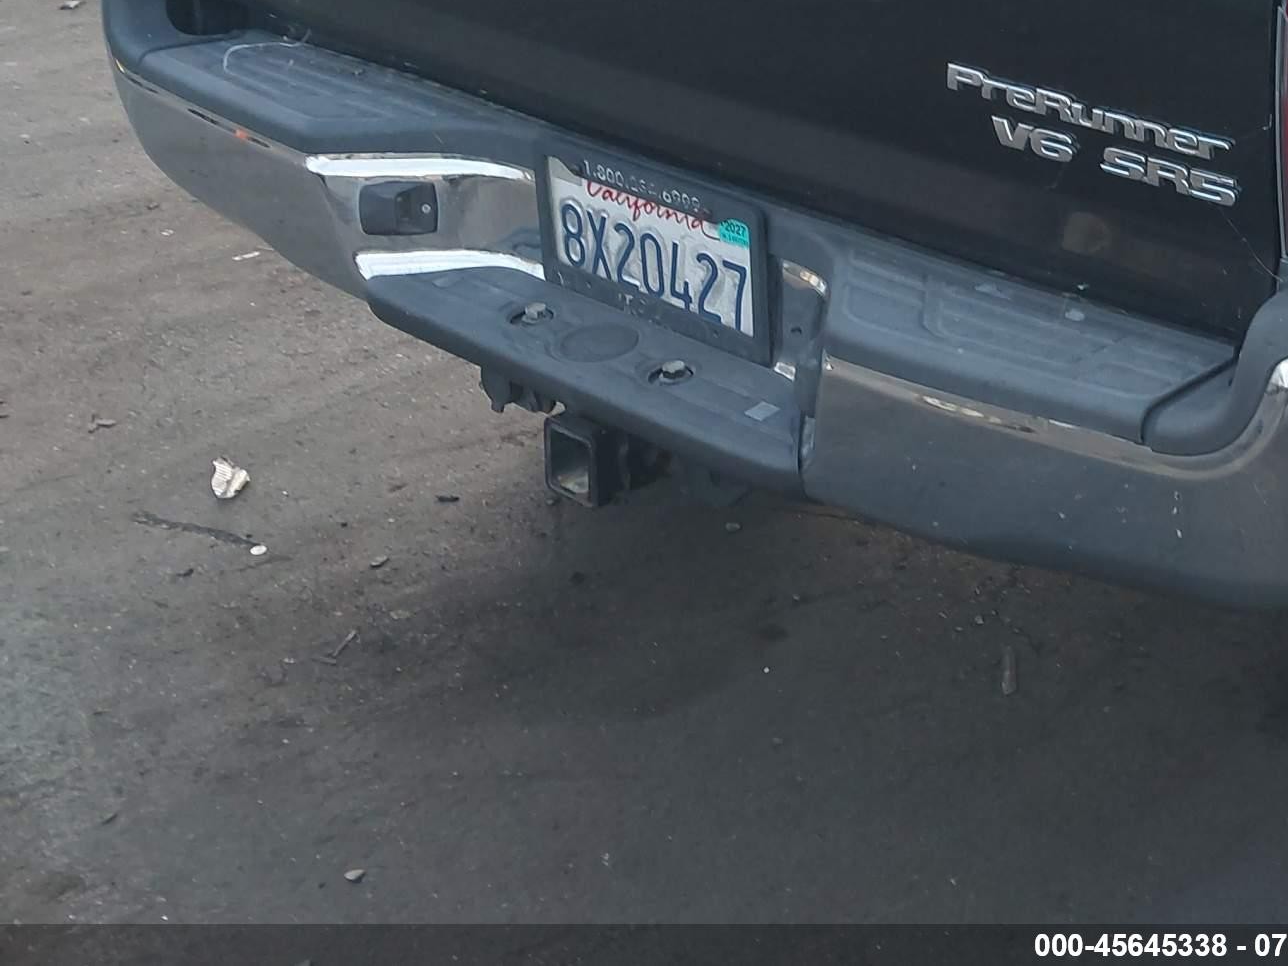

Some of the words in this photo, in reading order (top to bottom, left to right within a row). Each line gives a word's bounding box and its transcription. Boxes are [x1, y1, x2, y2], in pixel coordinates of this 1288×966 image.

[946, 62, 1233, 160] PreRunner
[991, 114, 1075, 163] V6
[1099, 146, 1238, 207] SR5
[561, 202, 748, 331] 8X20427
[723, 219, 746, 238] 2027
